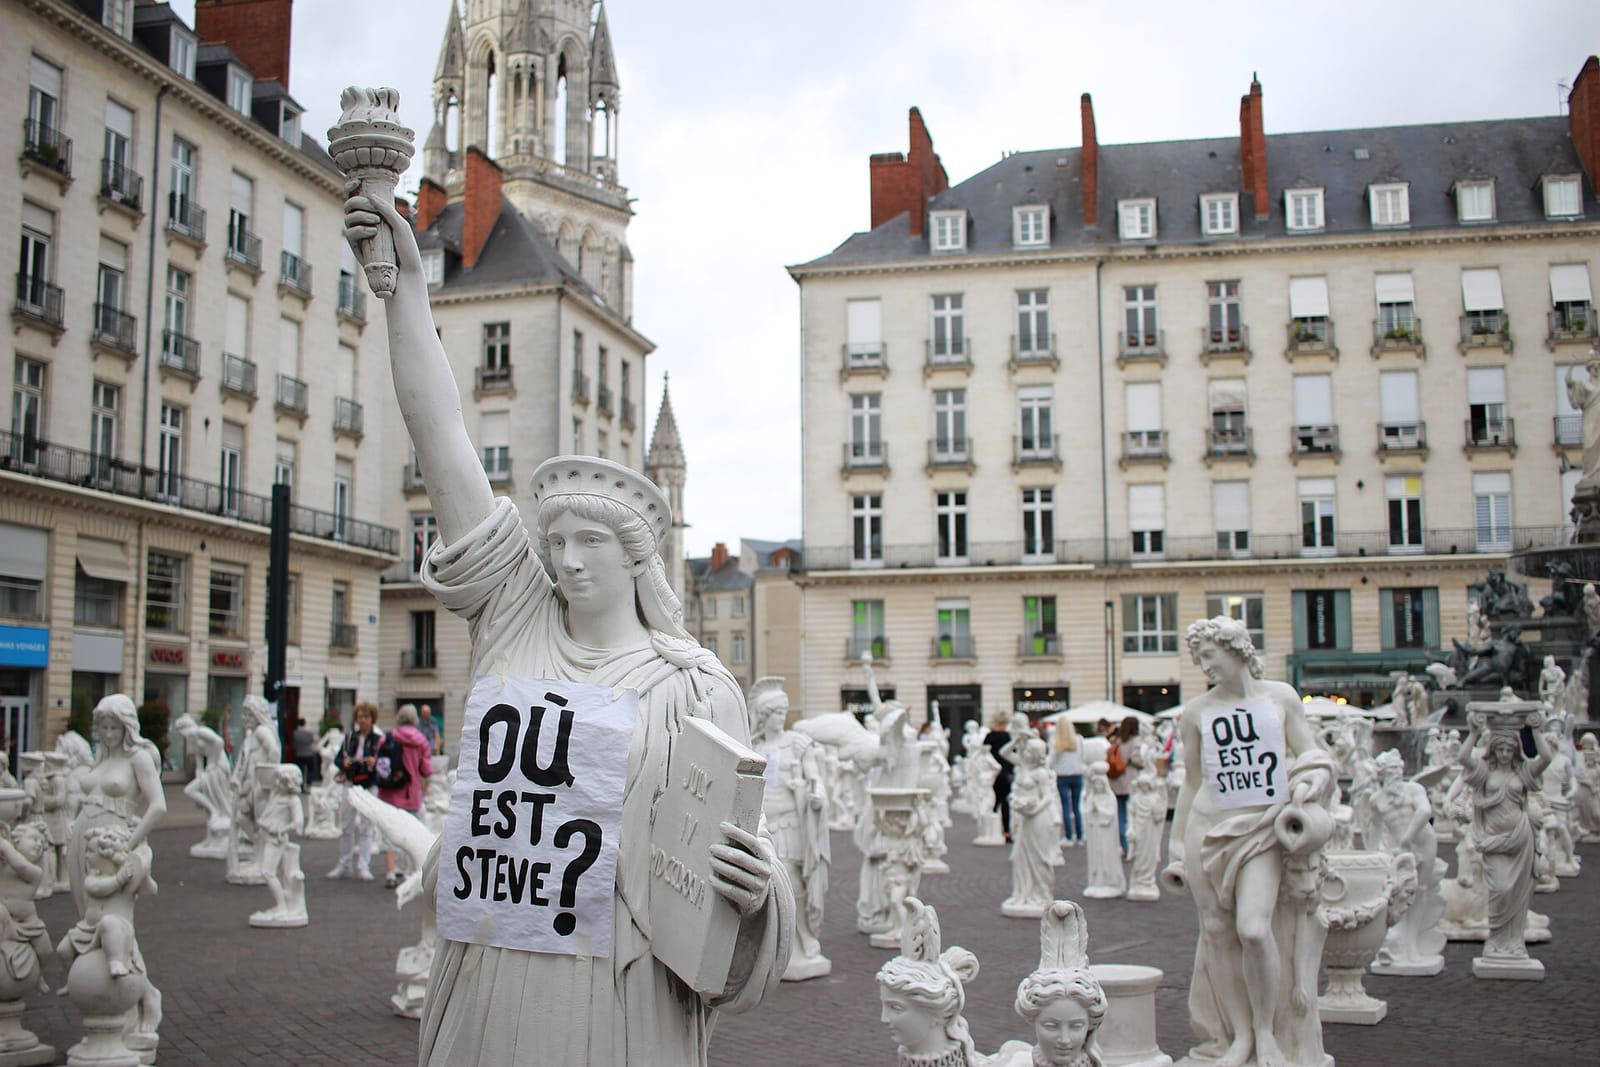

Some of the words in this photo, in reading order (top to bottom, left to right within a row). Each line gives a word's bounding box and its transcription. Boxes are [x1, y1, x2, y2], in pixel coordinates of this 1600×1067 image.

[477, 692, 575, 788] OÙ
[1212, 708, 1260, 747] OÙ
[1218, 745, 1255, 768] EST
[471, 790, 556, 846] EST
